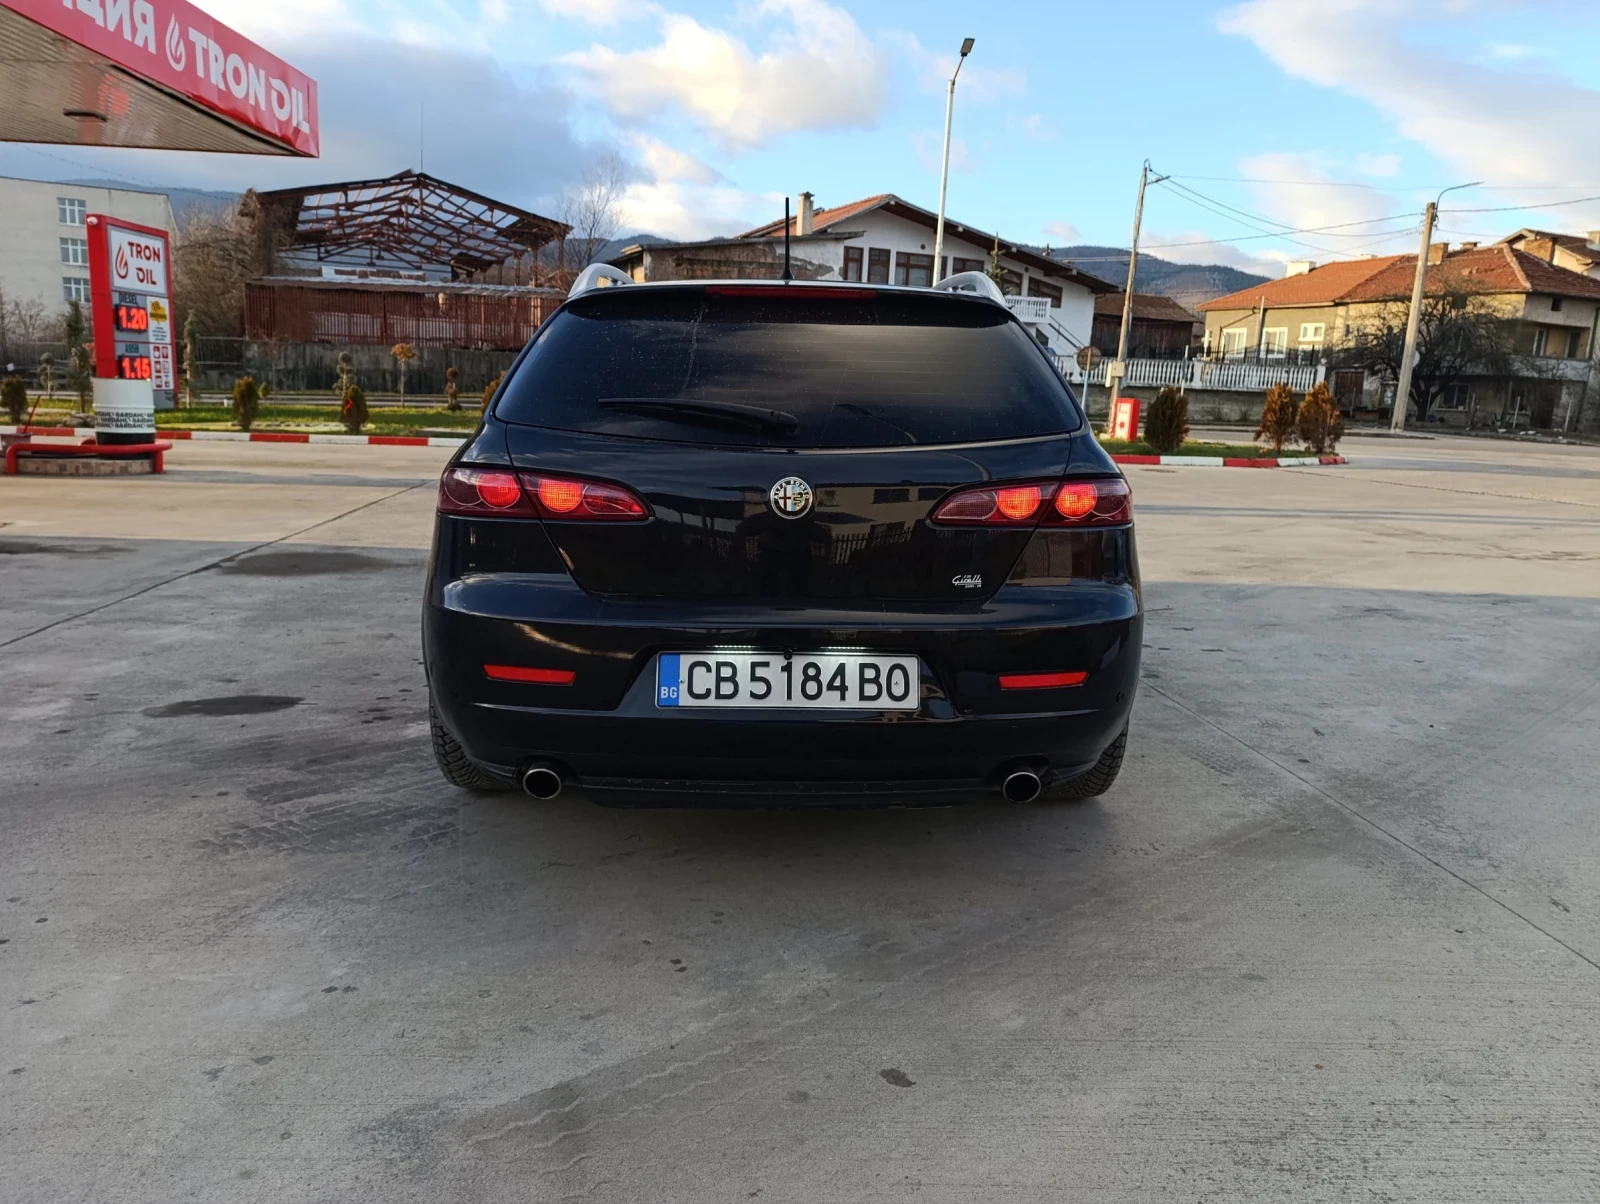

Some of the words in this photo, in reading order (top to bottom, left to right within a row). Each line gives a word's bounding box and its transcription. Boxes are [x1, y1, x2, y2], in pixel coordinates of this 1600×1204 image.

[188, 26, 266, 111] TRON
[269, 76, 310, 134] OIL
[127, 241, 161, 263] TRON
[135, 266, 156, 285] OIL
[119, 306, 147, 330] 1.20
[122, 357, 151, 379] 1.15
[687, 660, 739, 700] CB
[749, 661, 848, 701] 5184
[661, 686, 678, 699] BG
